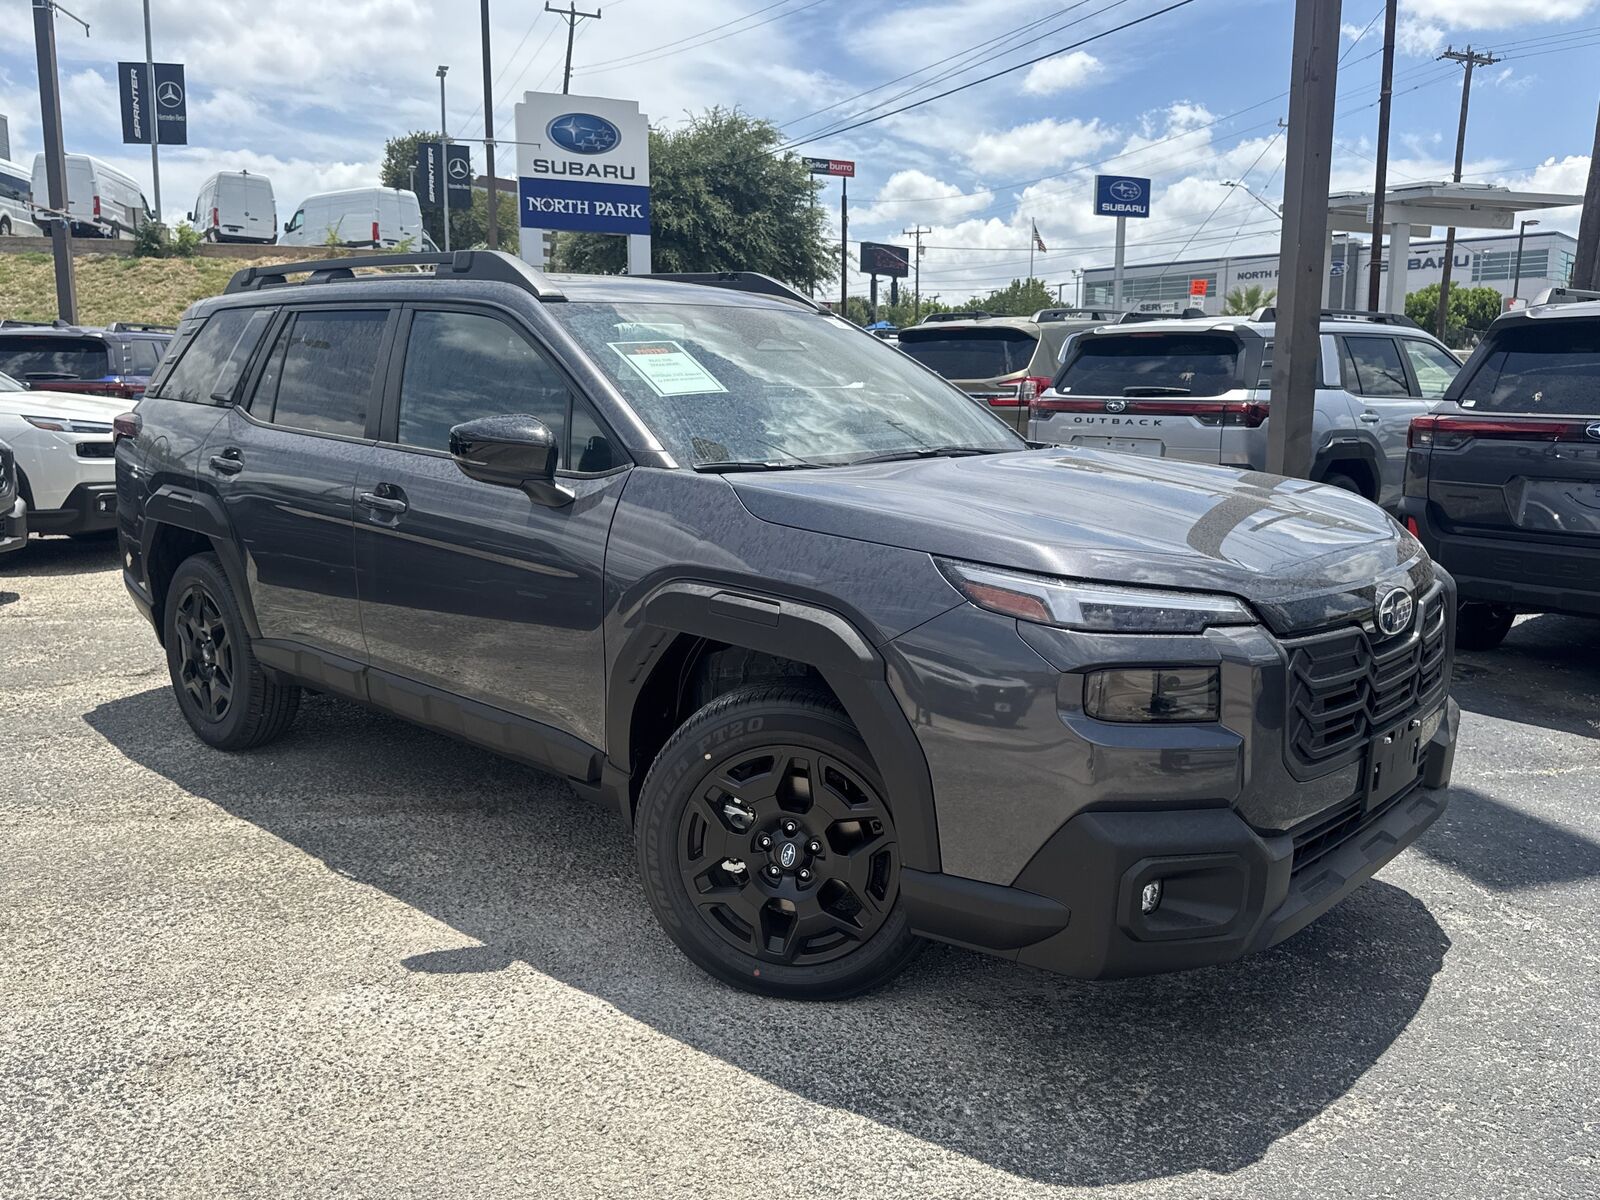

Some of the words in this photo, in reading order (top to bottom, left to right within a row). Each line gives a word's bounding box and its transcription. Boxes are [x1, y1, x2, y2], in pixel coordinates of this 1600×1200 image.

[130, 68, 142, 139] SPRINTER
[533, 158, 636, 180] SUBARU
[829, 160, 853, 172] burro
[427, 147, 436, 203] SPRINTER
[526, 196, 590, 215] NORTH
[594, 201, 645, 219] PARK
[1102, 203, 1147, 214] SUBARU
[1379, 254, 1470, 273] SBAU
[1237, 270, 1272, 280] NORTH
[1140, 301, 1179, 312] SERVE
[1073, 416, 1163, 427] OUTBACK
[1517, 447, 1600, 458] OUT
[698, 717, 764, 753] PT20
